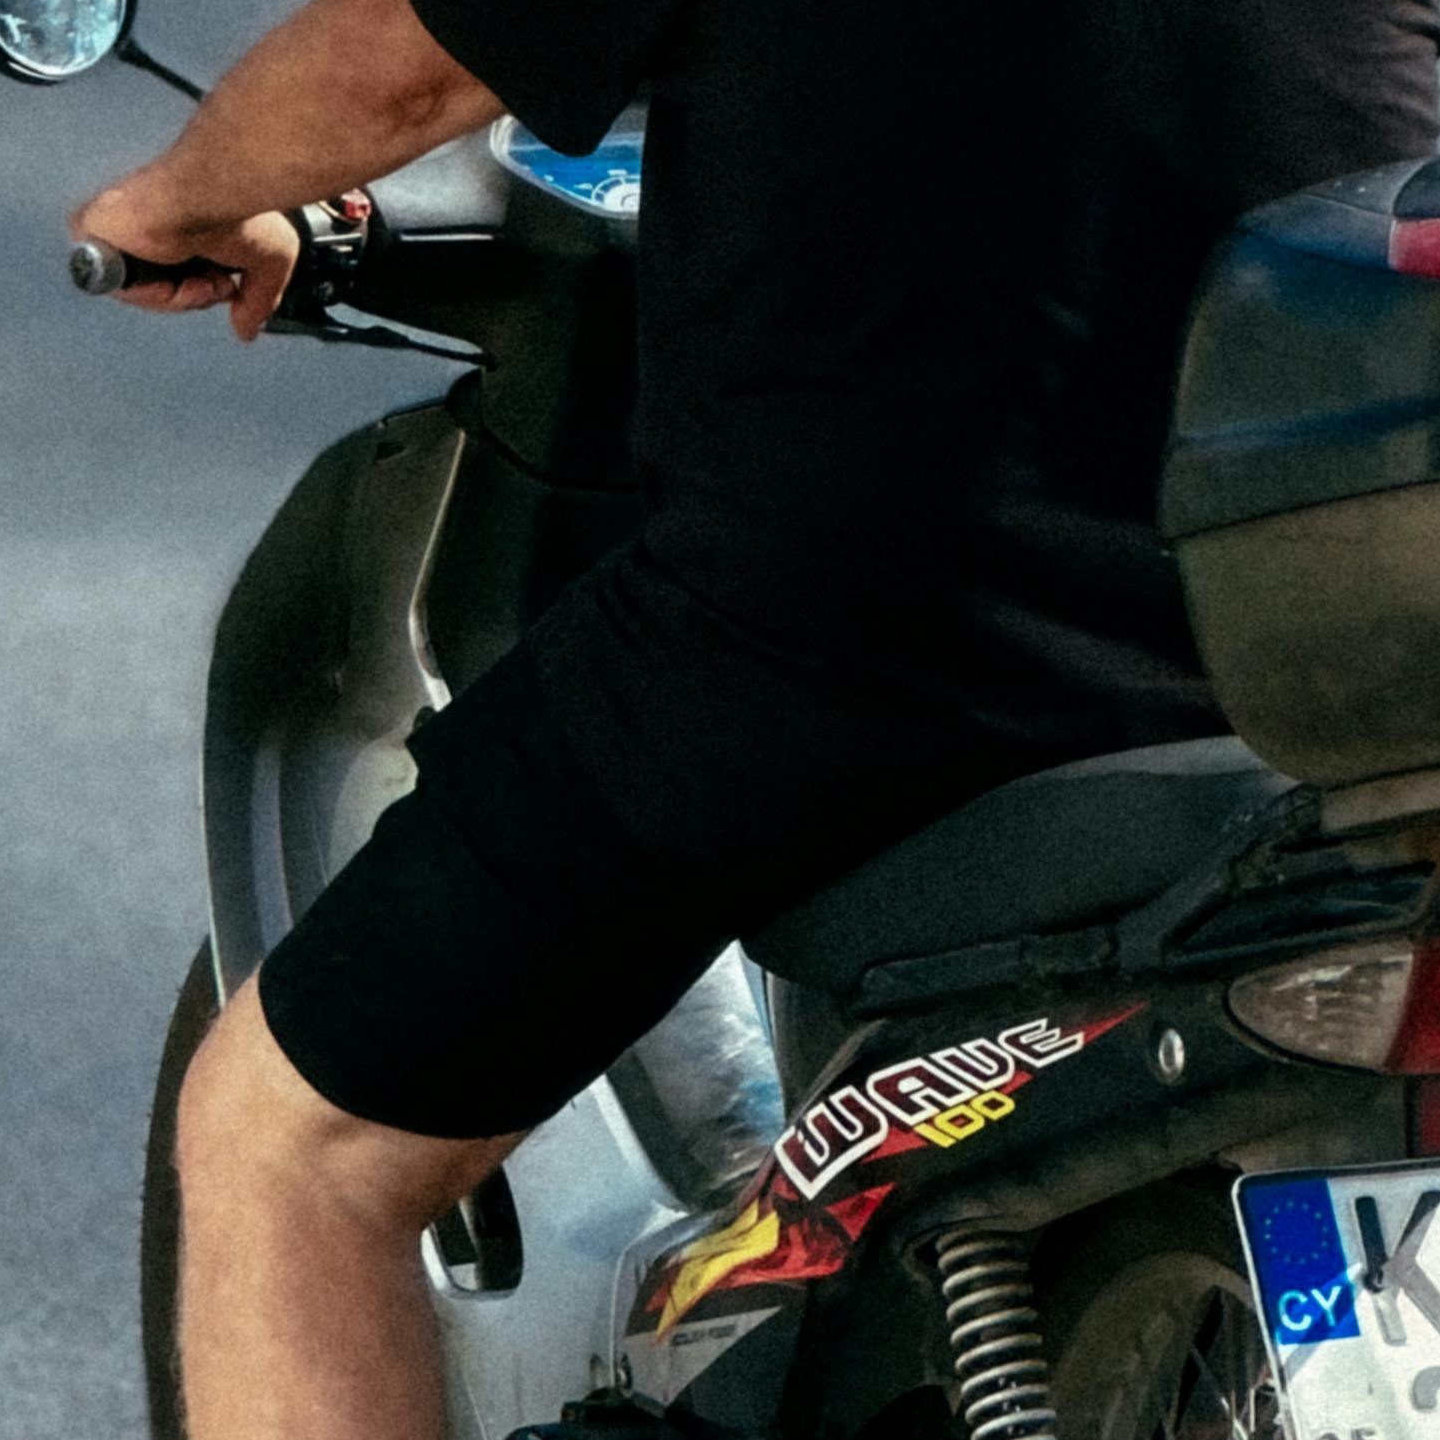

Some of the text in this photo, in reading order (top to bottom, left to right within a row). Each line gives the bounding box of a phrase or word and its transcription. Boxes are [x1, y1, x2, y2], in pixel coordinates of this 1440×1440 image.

[774, 1018, 1084, 1200] WAVE
[914, 1090, 1015, 1148] 100
[1278, 1286, 1342, 1331] CY
